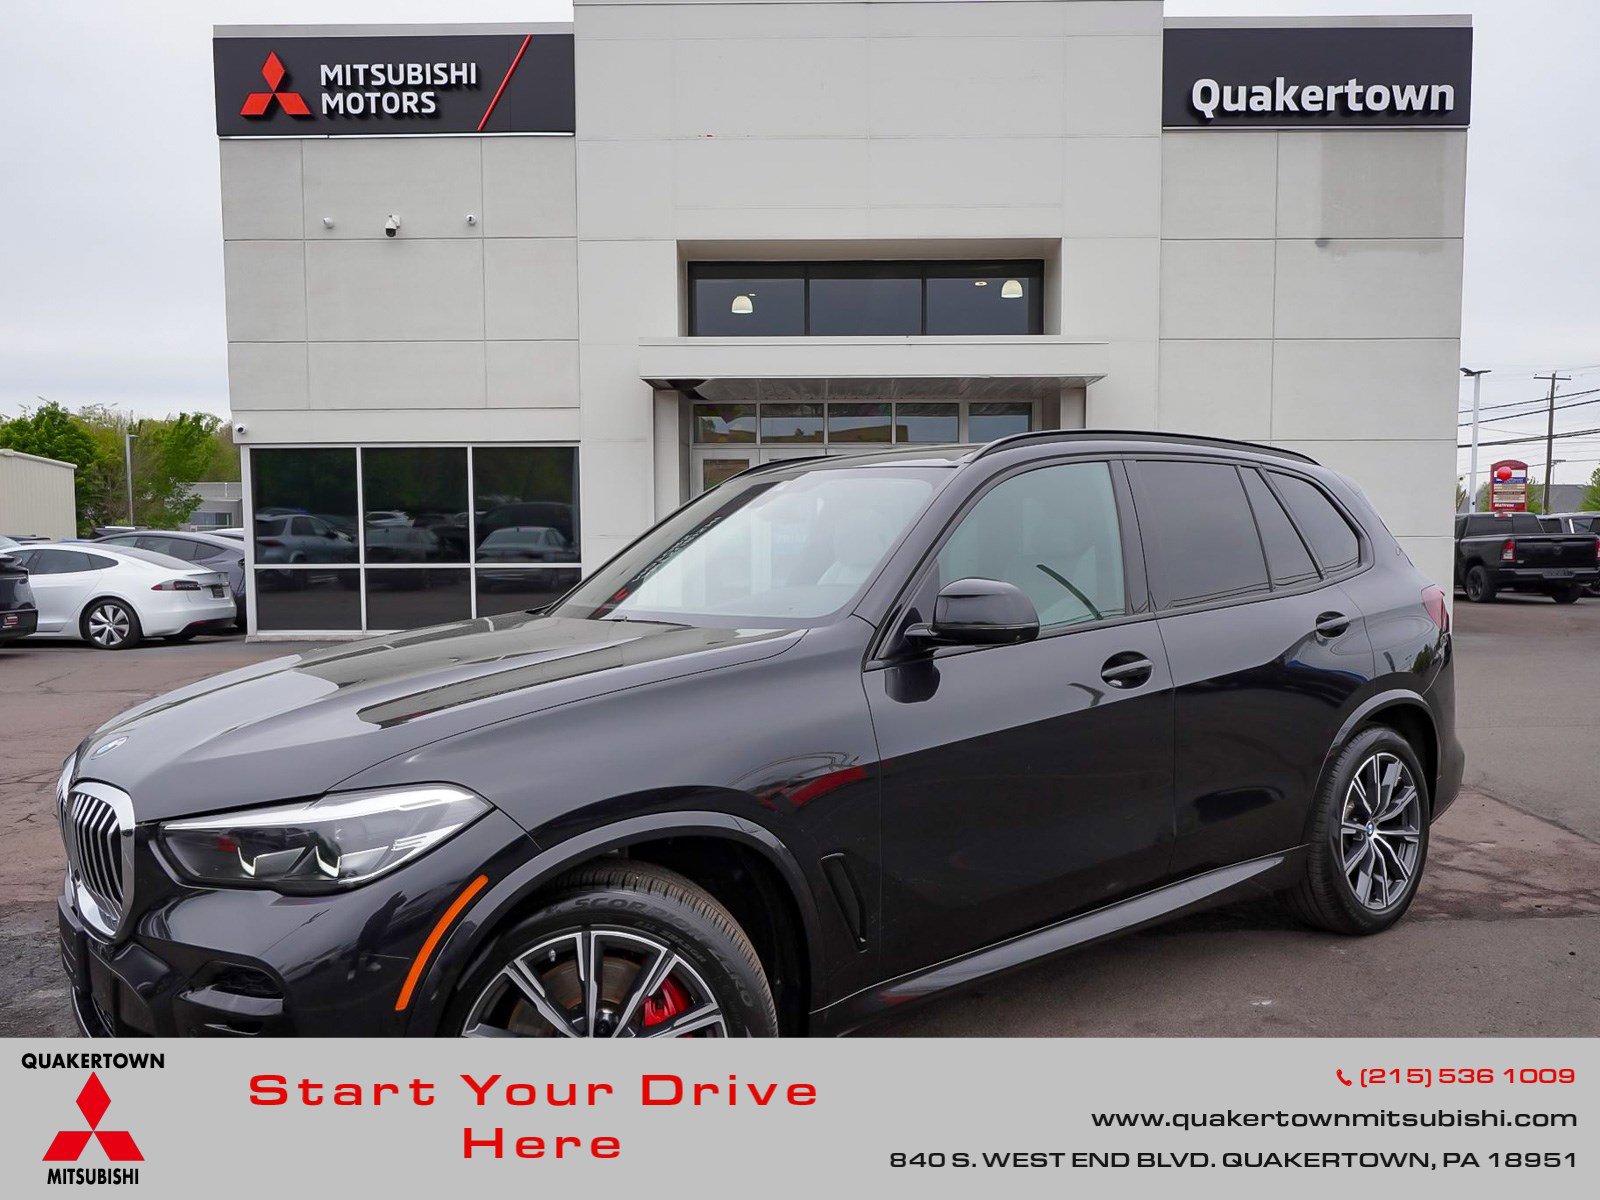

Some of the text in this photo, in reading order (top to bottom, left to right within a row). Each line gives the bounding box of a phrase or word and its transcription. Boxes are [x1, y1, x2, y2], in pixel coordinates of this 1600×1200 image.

[320, 62, 477, 86] MITSUBISHI
[321, 91, 436, 115] MOTORS
[1191, 76, 1455, 119] Quakertown
